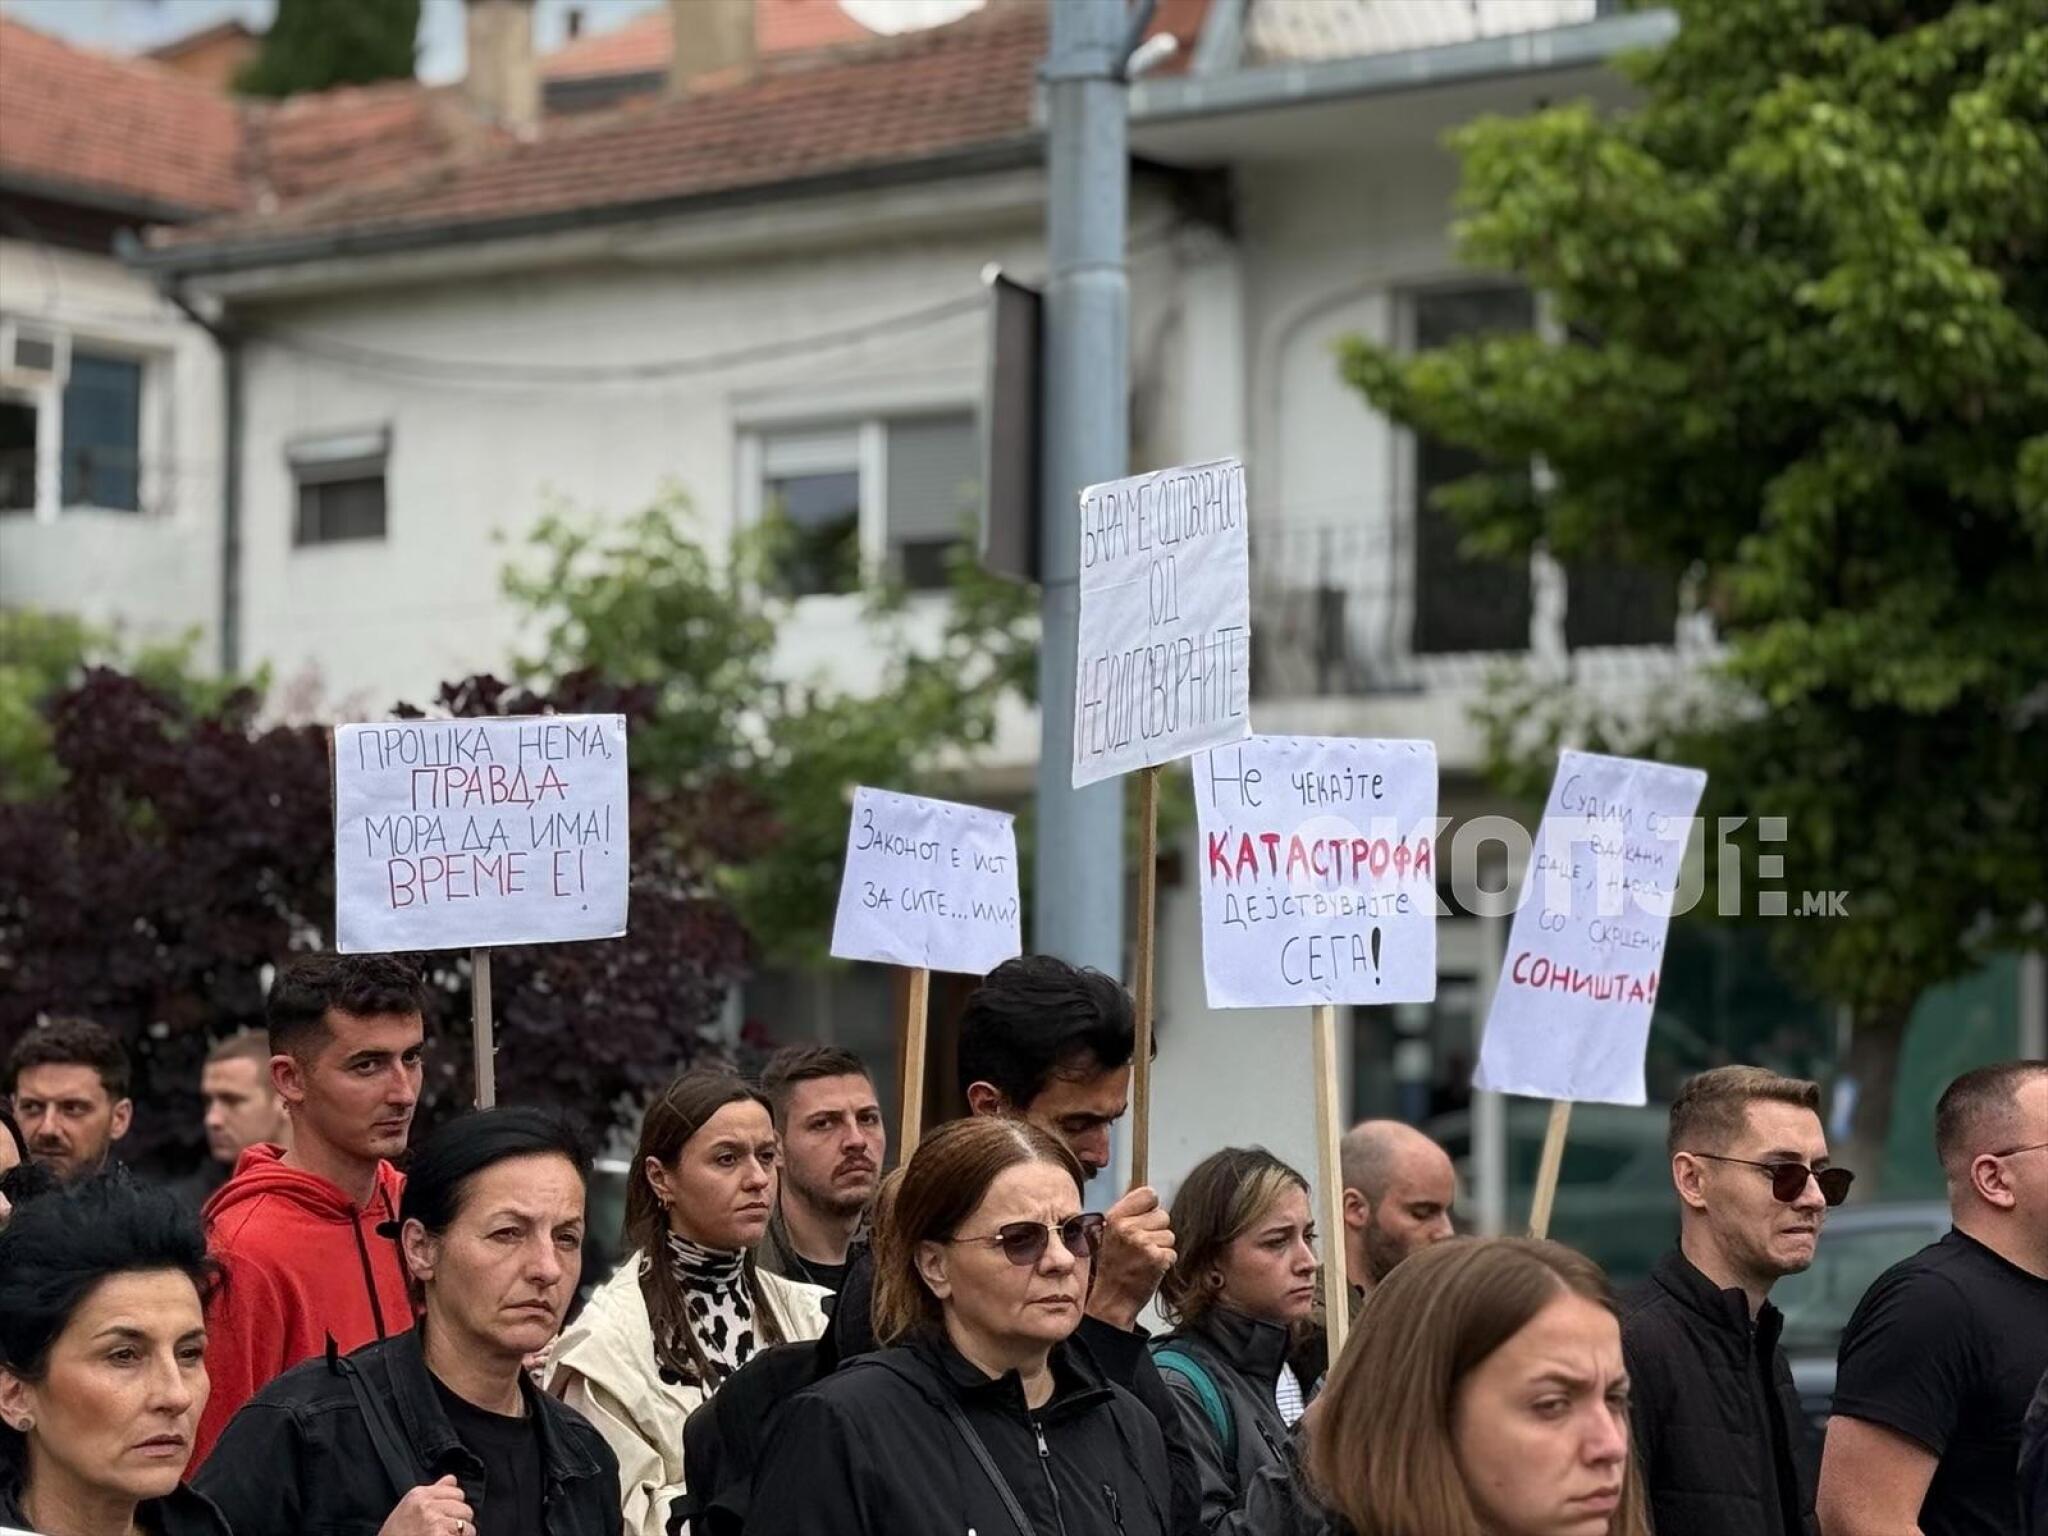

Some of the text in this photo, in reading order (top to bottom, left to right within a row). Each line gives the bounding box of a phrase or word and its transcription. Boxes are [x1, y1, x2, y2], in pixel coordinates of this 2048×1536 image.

[1085, 484, 1152, 568] БАРАМЕ
[1151, 555, 1180, 626] ОД
[1078, 626, 1243, 764] НЕОДГОВОРНИТЕ
[357, 724, 612, 771] ПРОШКА НЕМА,
[1209, 747, 1262, 808] Не
[411, 763, 569, 811] ПРАВДА
[365, 804, 610, 857] МОРА ДА ИМА!
[1208, 825, 1431, 886] КАТАСТРОФА
[387, 850, 589, 911] ВРЕМЕ Е!
[862, 881, 893, 910] ЗА
[1281, 926, 1382, 986] СЕГА!
[1512, 951, 1659, 1005] СОНИШТА!
